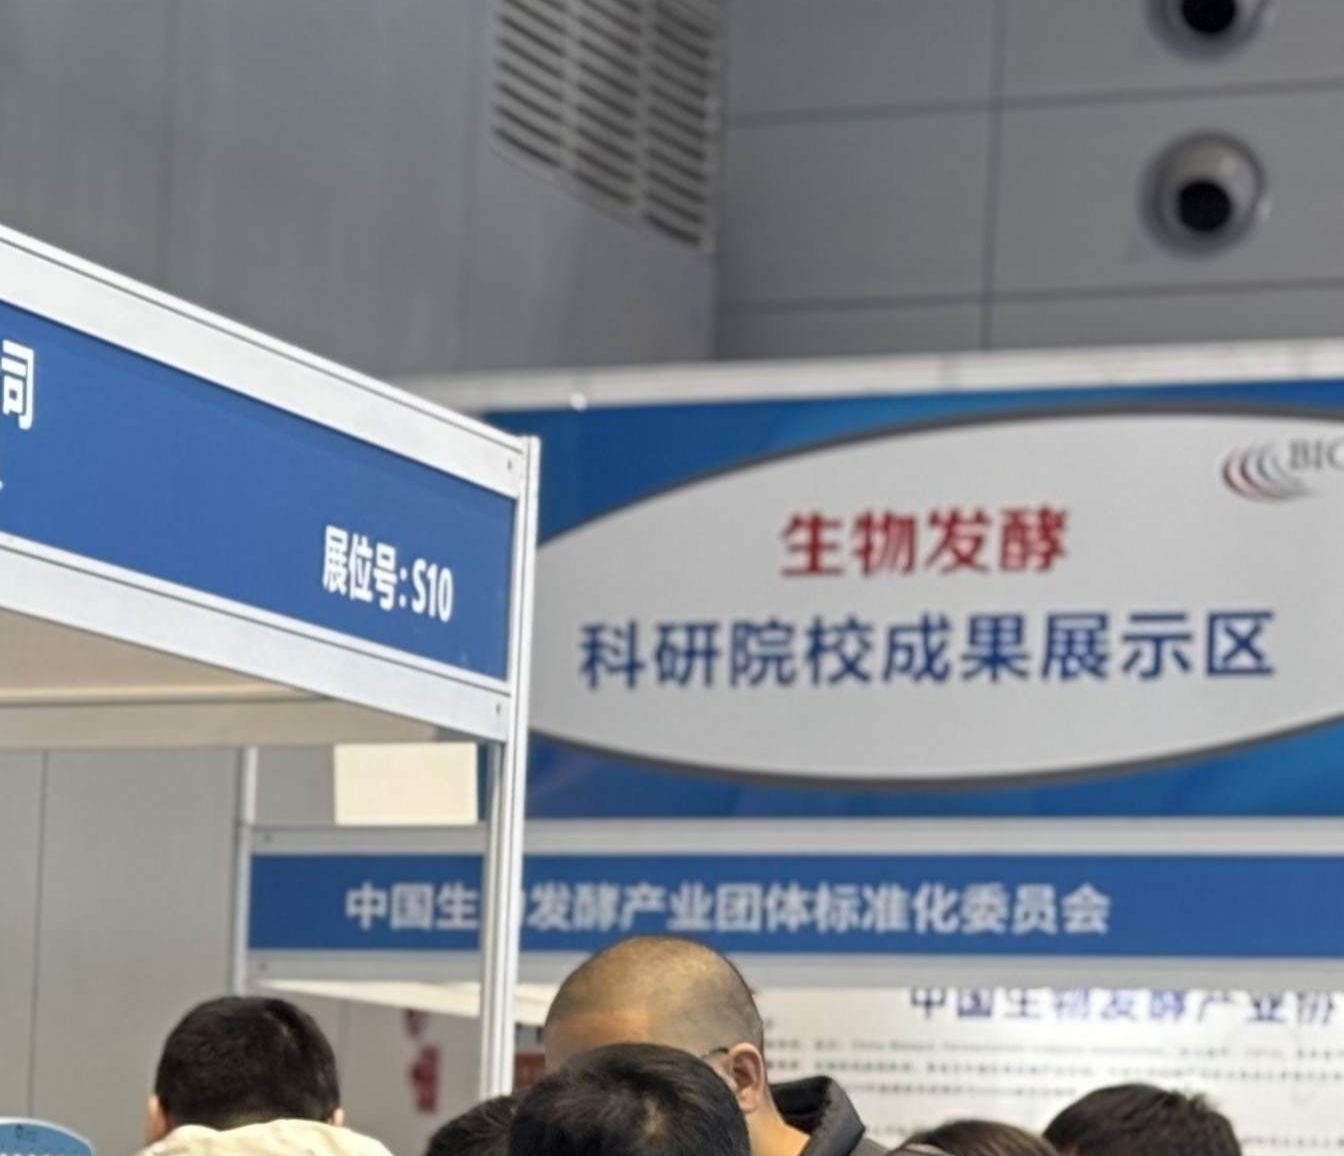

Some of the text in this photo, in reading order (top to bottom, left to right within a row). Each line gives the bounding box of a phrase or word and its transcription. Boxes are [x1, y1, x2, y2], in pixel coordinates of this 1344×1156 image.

[779, 504, 1071, 579] 生物发酵
[579, 609, 1275, 691] 科研院校成果展示区
[345, 881, 1111, 935] 中国生发酵产业团体标准化委员会
